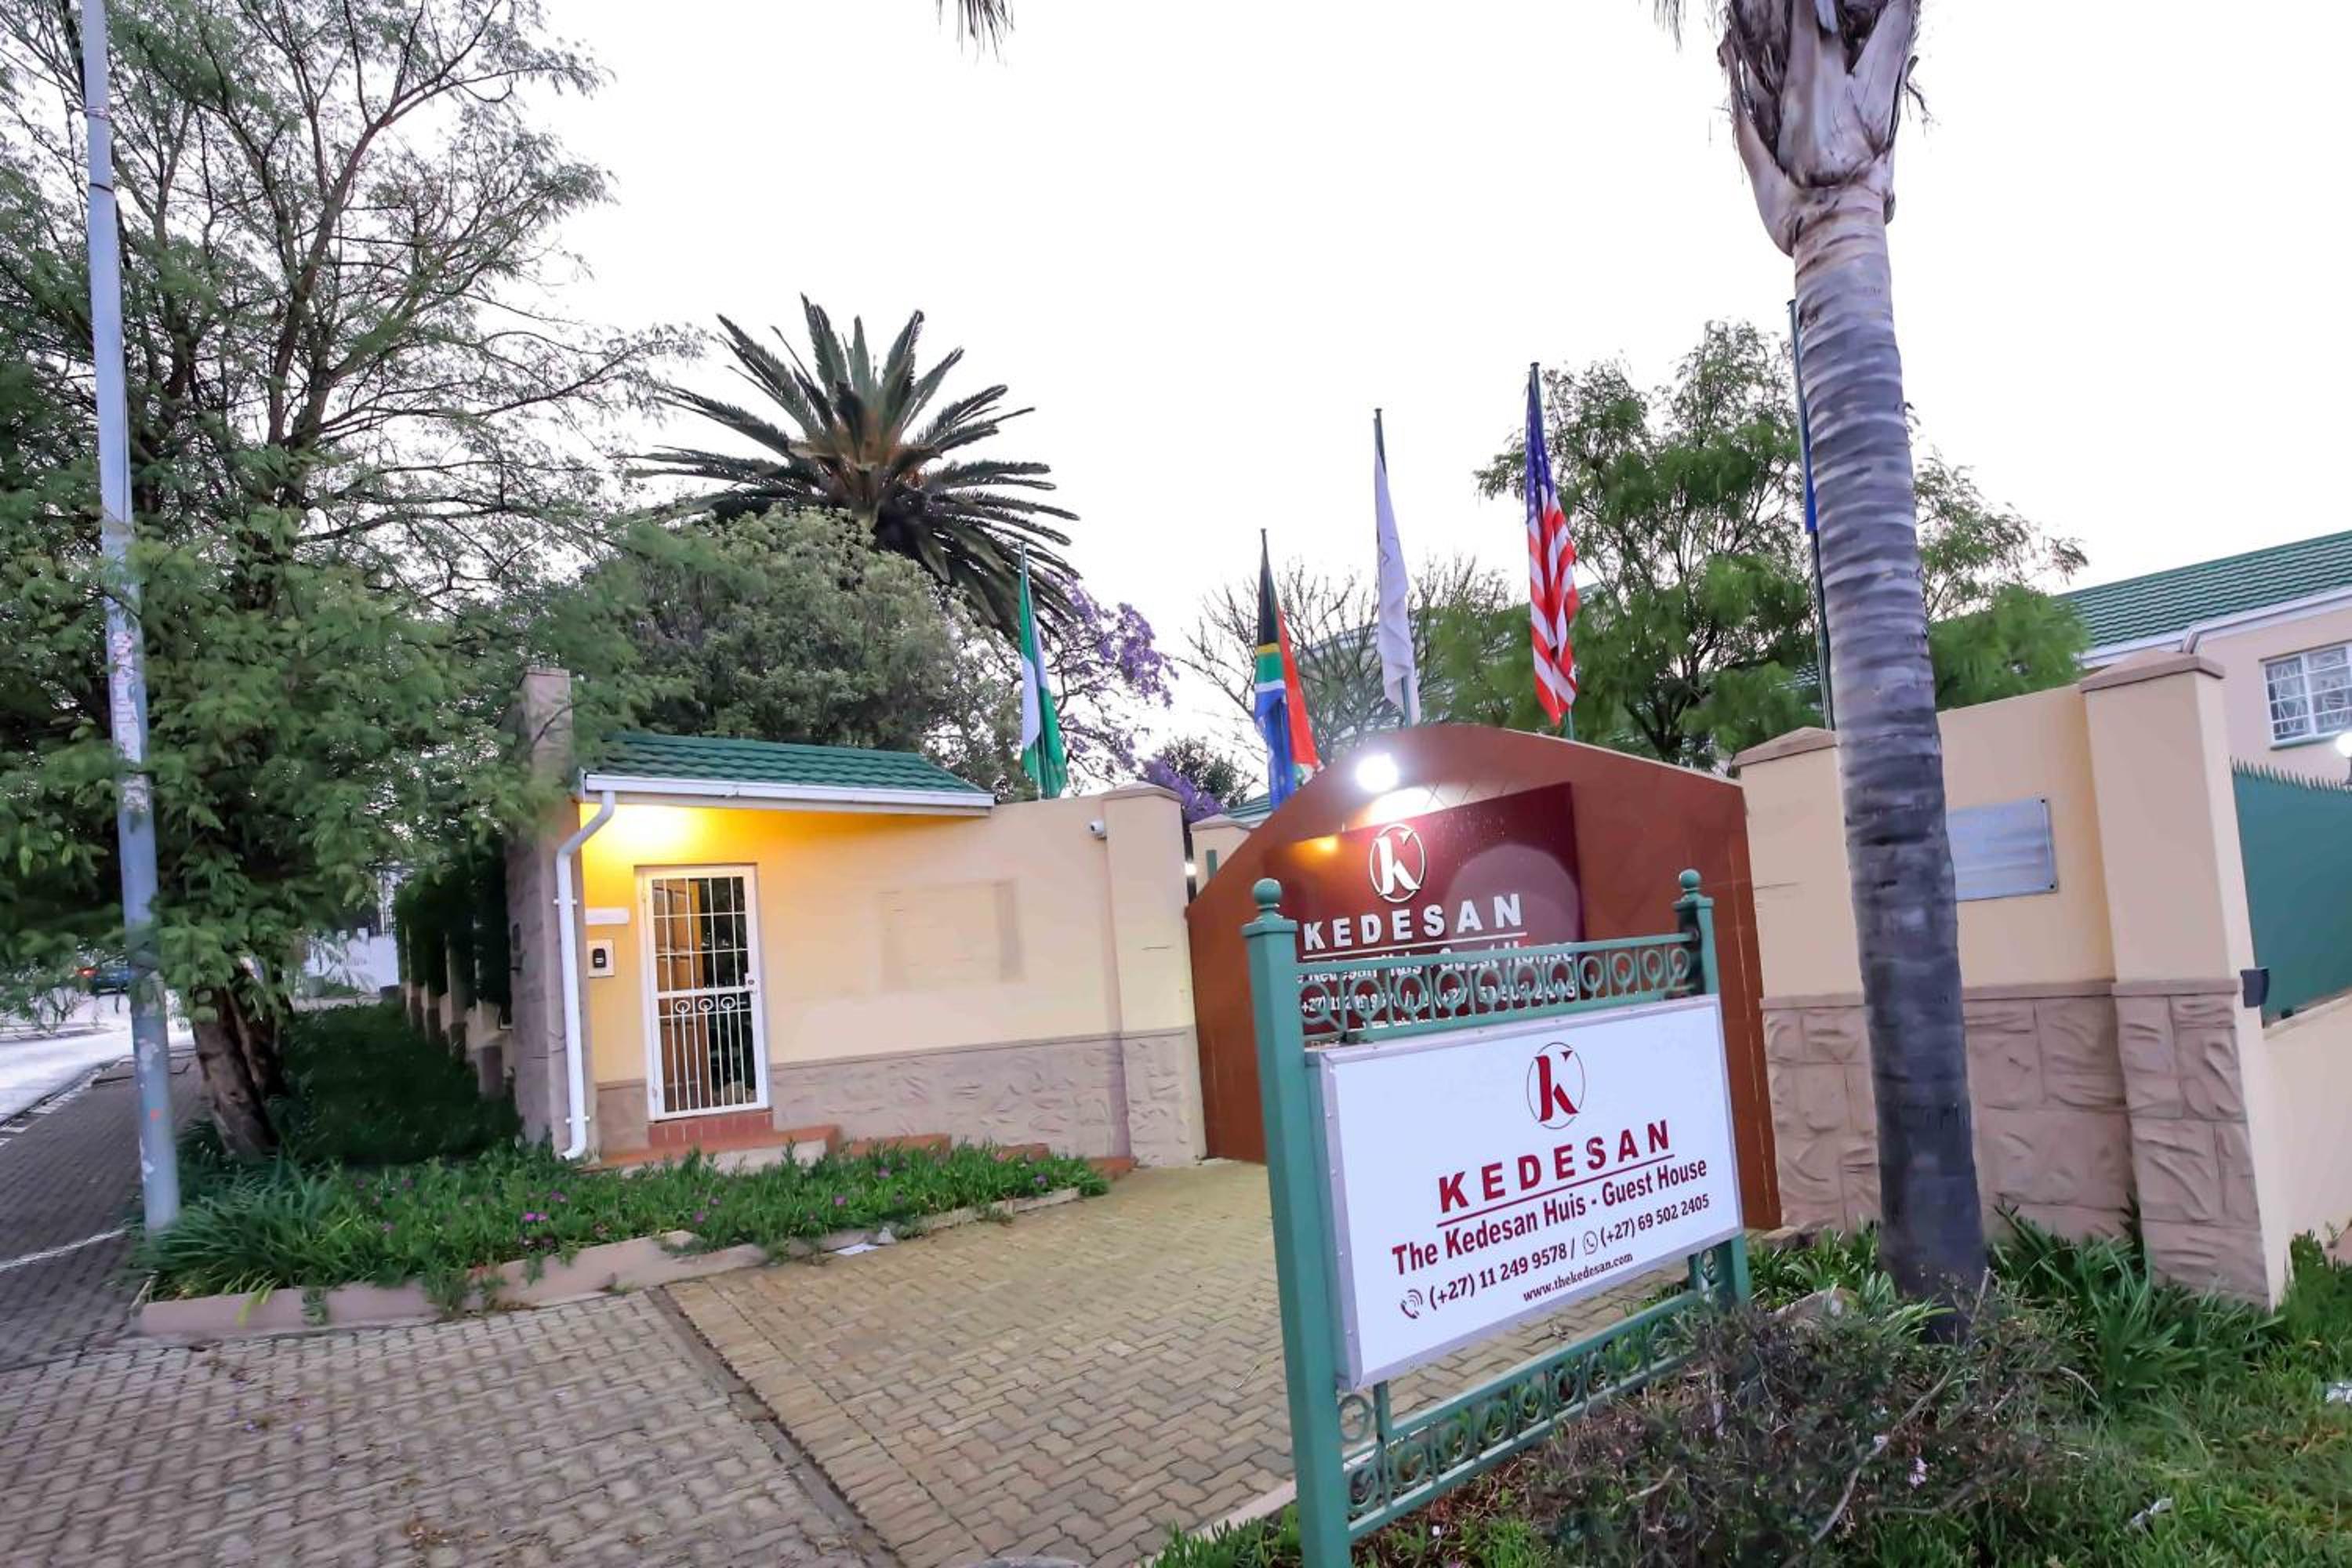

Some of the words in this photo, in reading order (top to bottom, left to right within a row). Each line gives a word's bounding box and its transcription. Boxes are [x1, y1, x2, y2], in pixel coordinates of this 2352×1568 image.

[1304, 894, 1523, 951] KEDESAN
[1439, 1120, 1670, 1214] KEDESAN
[1392, 1242, 1438, 1276] The
[1445, 1211, 1538, 1259] Kedesan
[1543, 1193, 1586, 1227] Huis
[1602, 1172, 1653, 1207] Guest
[1657, 1159, 1708, 1191] House
[1429, 1273, 1475, 1311] (+27)
[1480, 1268, 1497, 1288] 11
[1500, 1256, 1528, 1282] 249
[1531, 1243, 1567, 1269] 9578
[1600, 1218, 1636, 1247] (+27)
[1638, 1213, 1653, 1231] 69
[1656, 1204, 1679, 1225] 502
[1681, 1193, 1710, 1217] 2405
[1523, 1252, 1633, 1302] www.thekedesan.com
